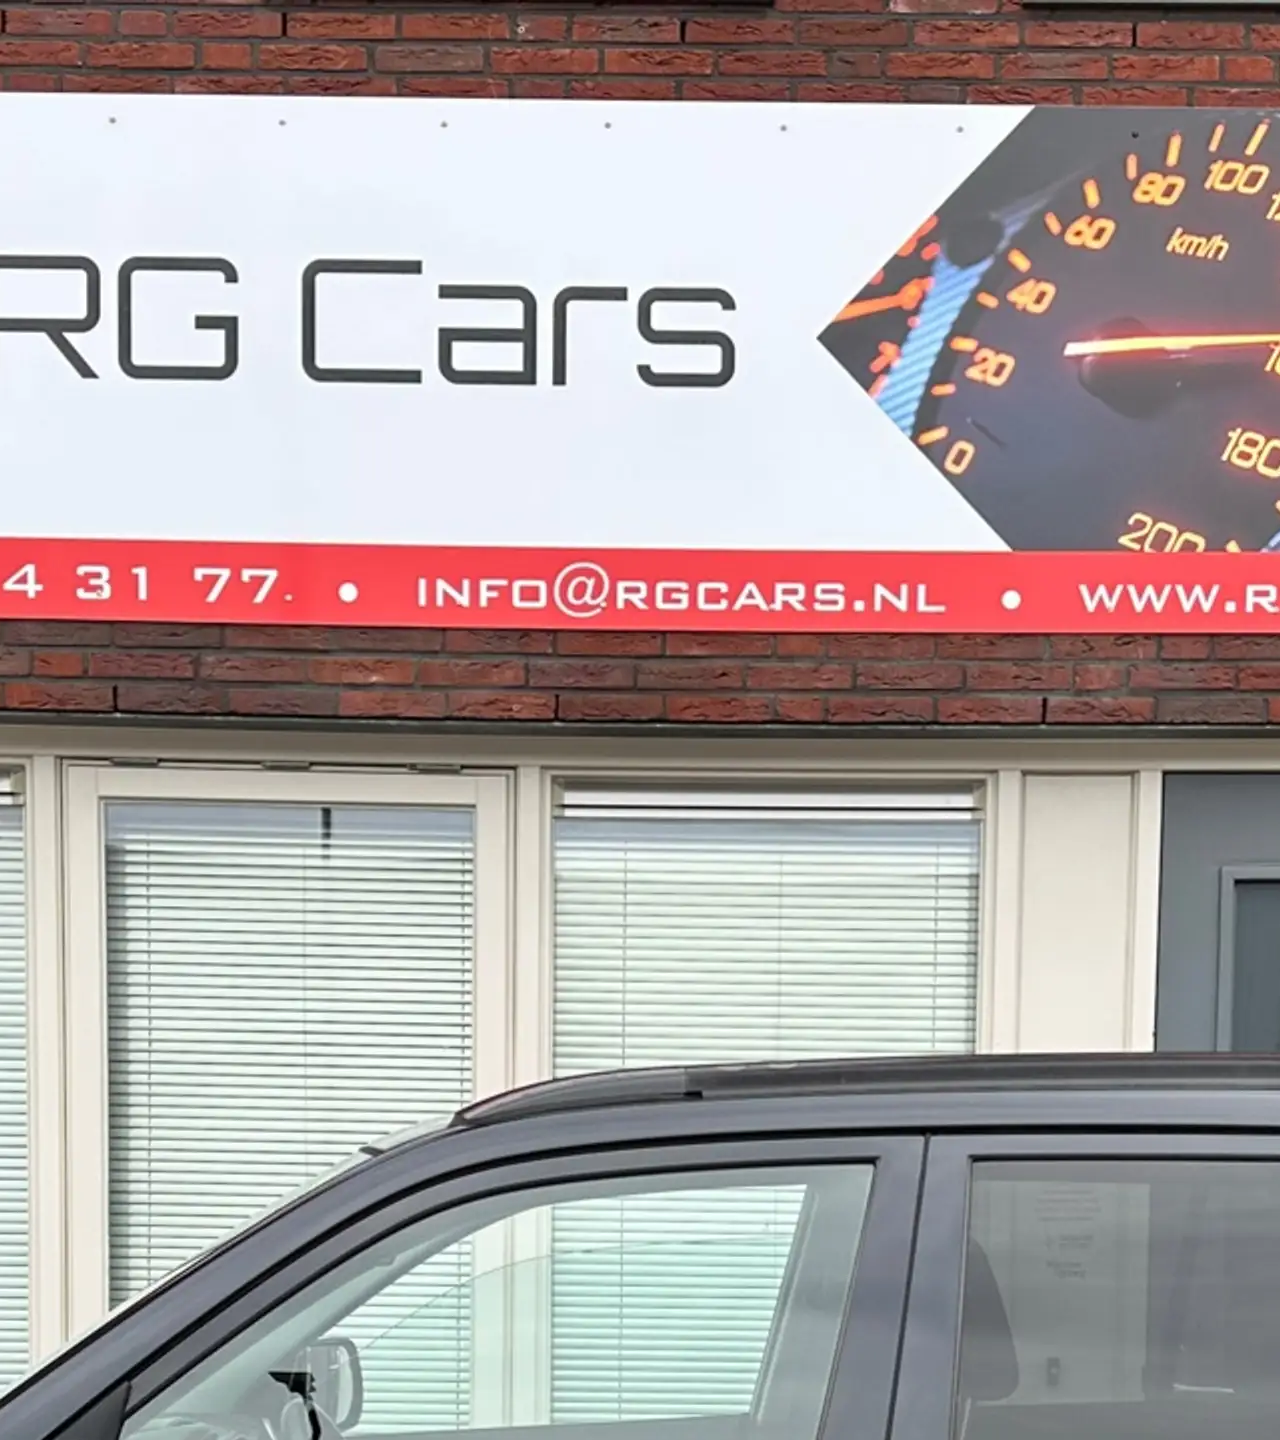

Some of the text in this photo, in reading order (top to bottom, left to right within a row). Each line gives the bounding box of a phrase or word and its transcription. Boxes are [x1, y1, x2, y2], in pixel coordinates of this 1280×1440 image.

[1131, 172, 1186, 207] 80
[1204, 158, 1270, 196] 100
[1063, 214, 1117, 251] 60
[1166, 227, 1230, 263] km/h
[1005, 277, 1057, 315] 40
[300, 257, 738, 389] Cars
[963, 346, 1016, 387] 20
[944, 440, 975, 475] 0
[76, 565, 148, 601] 31
[193, 567, 279, 604] 77
[417, 562, 947, 618] INFO@RGCARS.NL
